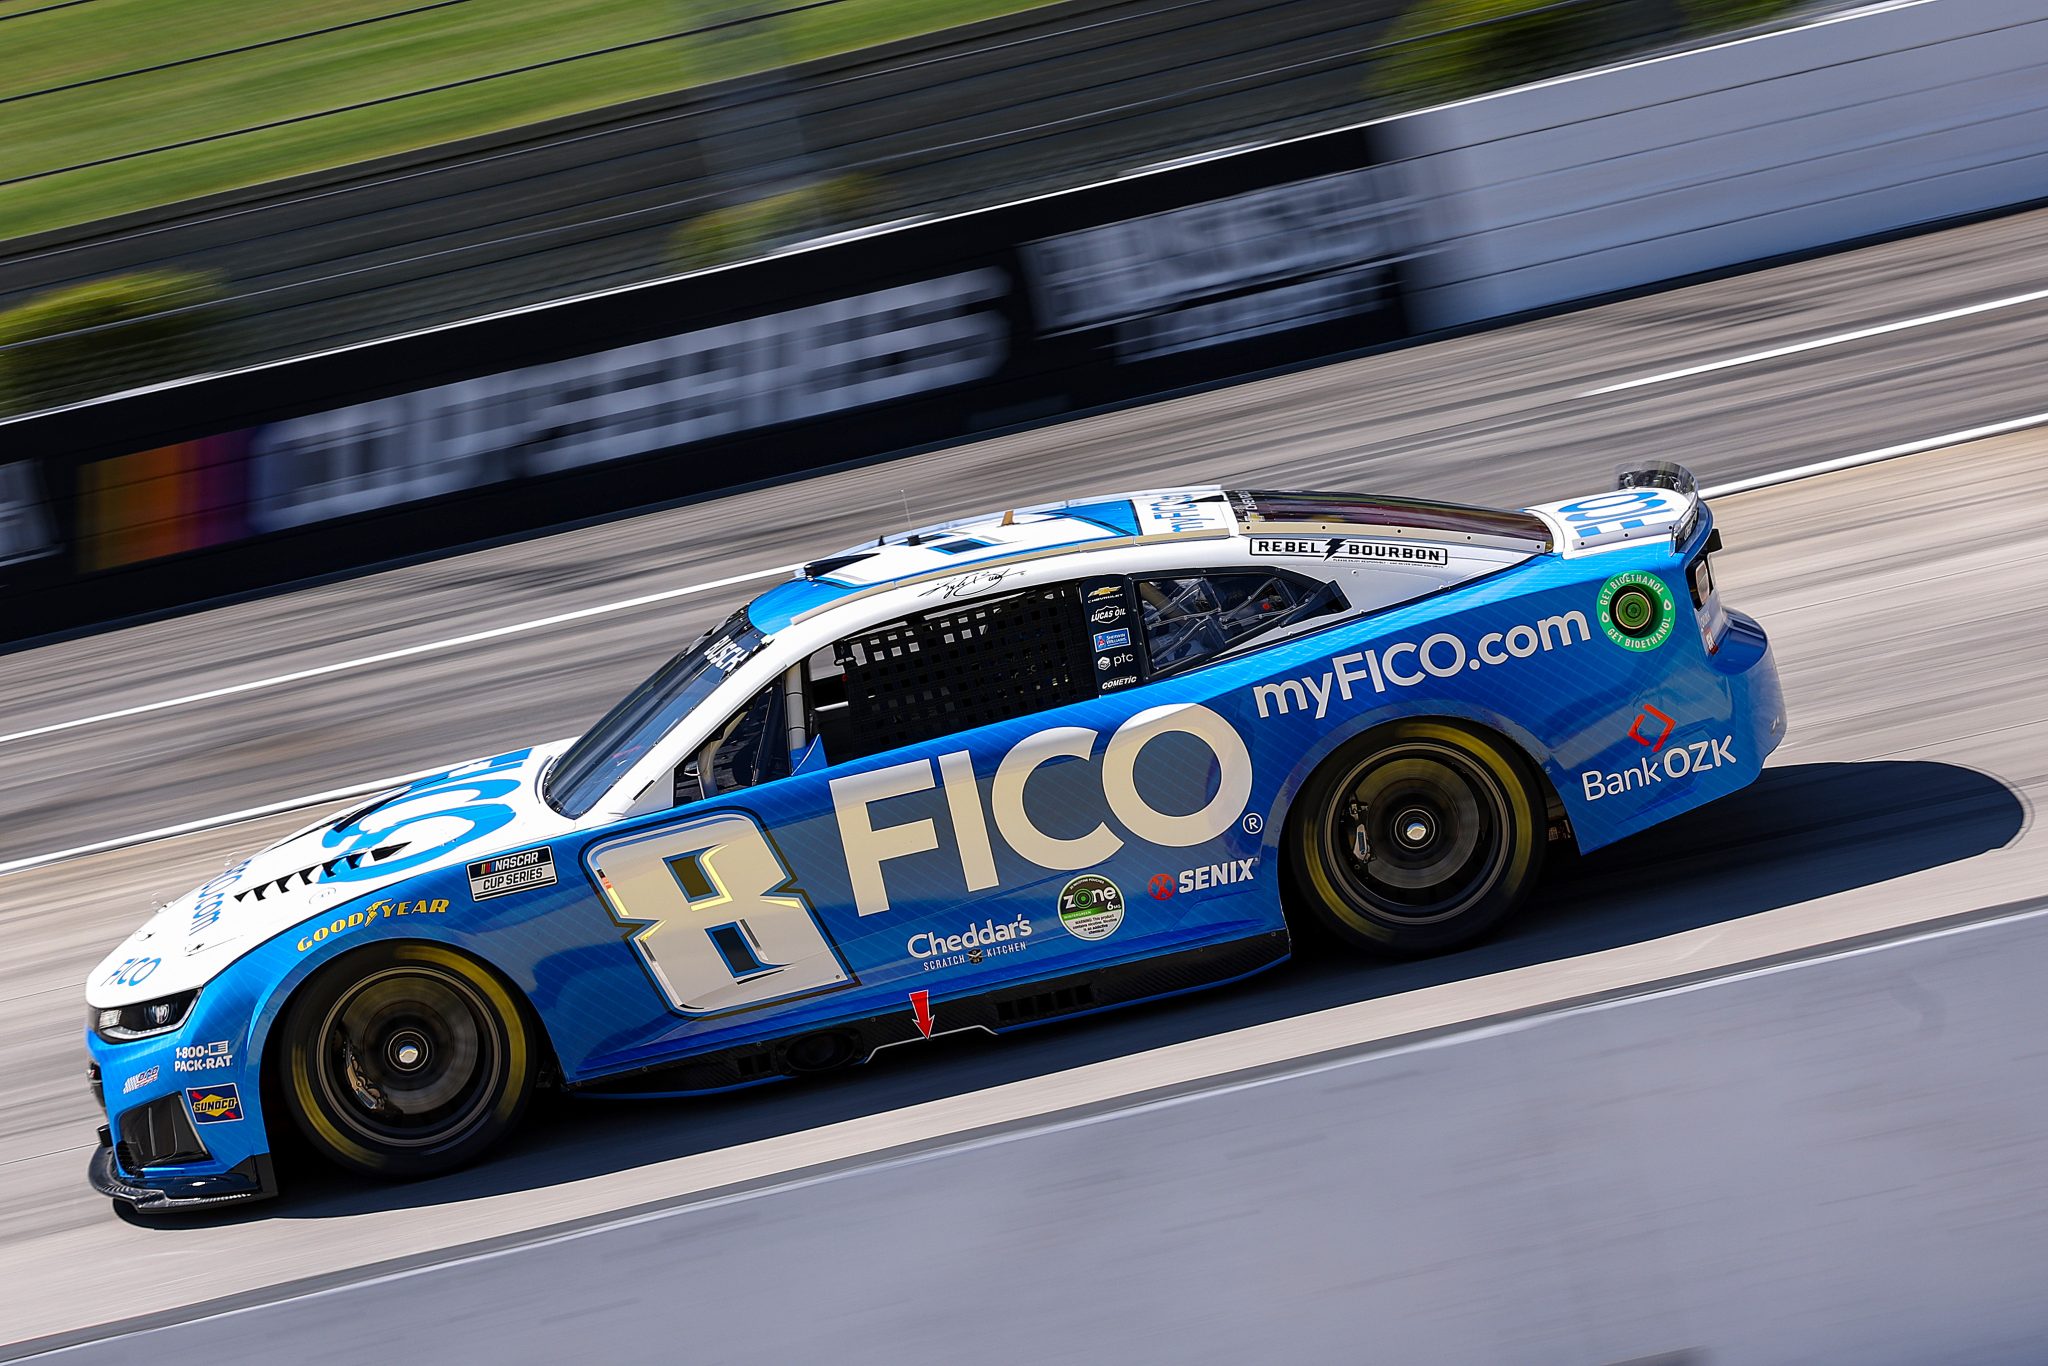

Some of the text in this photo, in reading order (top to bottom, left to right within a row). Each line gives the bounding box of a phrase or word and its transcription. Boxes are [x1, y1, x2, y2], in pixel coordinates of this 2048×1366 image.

[1258, 541, 1440, 561] REBEL BOURBON
[1600, 573, 1664, 606] GET BIOETHANOL
[1091, 608, 1126, 622] LUCAS OIL
[1608, 628, 1623, 643] GET
[1625, 617, 1671, 648] BIOETHANOL
[704, 635, 750, 672] BUSCH
[1113, 652, 1134, 667] ptc
[1252, 610, 1591, 720] myFICO.com
[1102, 675, 1137, 690] COMETIC
[1581, 734, 1737, 801] Bank OZK
[829, 703, 1253, 917] FICO
[495, 852, 539, 872] NASCAR
[1178, 857, 1255, 894] SENIX
[483, 868, 543, 891] CUP SERIES
[583, 808, 858, 1018] 8
[907, 913, 1033, 959] Cheddar's
[923, 941, 1028, 971] SCRATCH KITCHEN
[100, 957, 162, 986] FICO
[194, 1098, 235, 1112] SUNOCO
